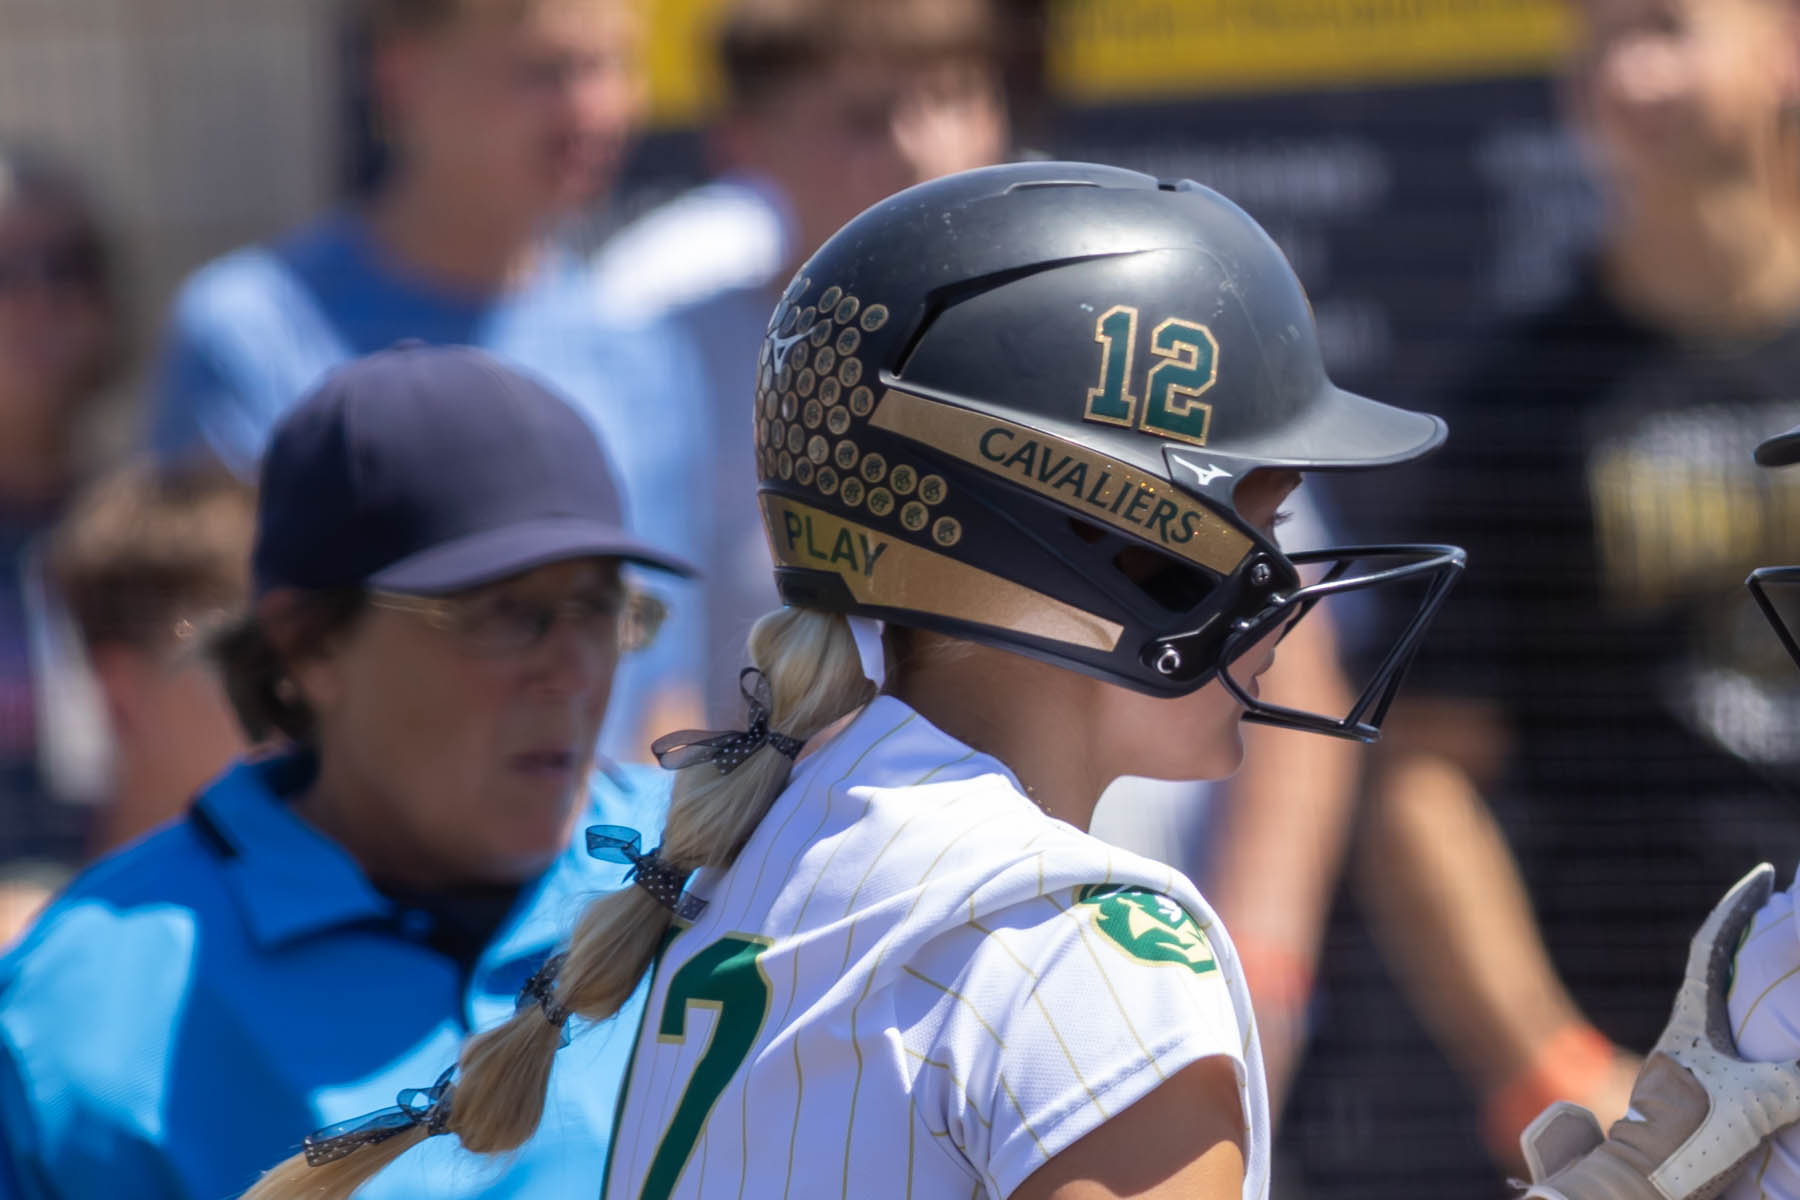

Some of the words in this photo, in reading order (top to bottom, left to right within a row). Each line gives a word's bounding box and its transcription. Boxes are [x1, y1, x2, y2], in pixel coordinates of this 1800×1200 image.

[1083, 304, 1220, 447] 12
[784, 509, 888, 577] PLAY
[979, 427, 1202, 544] CAVALIERS
